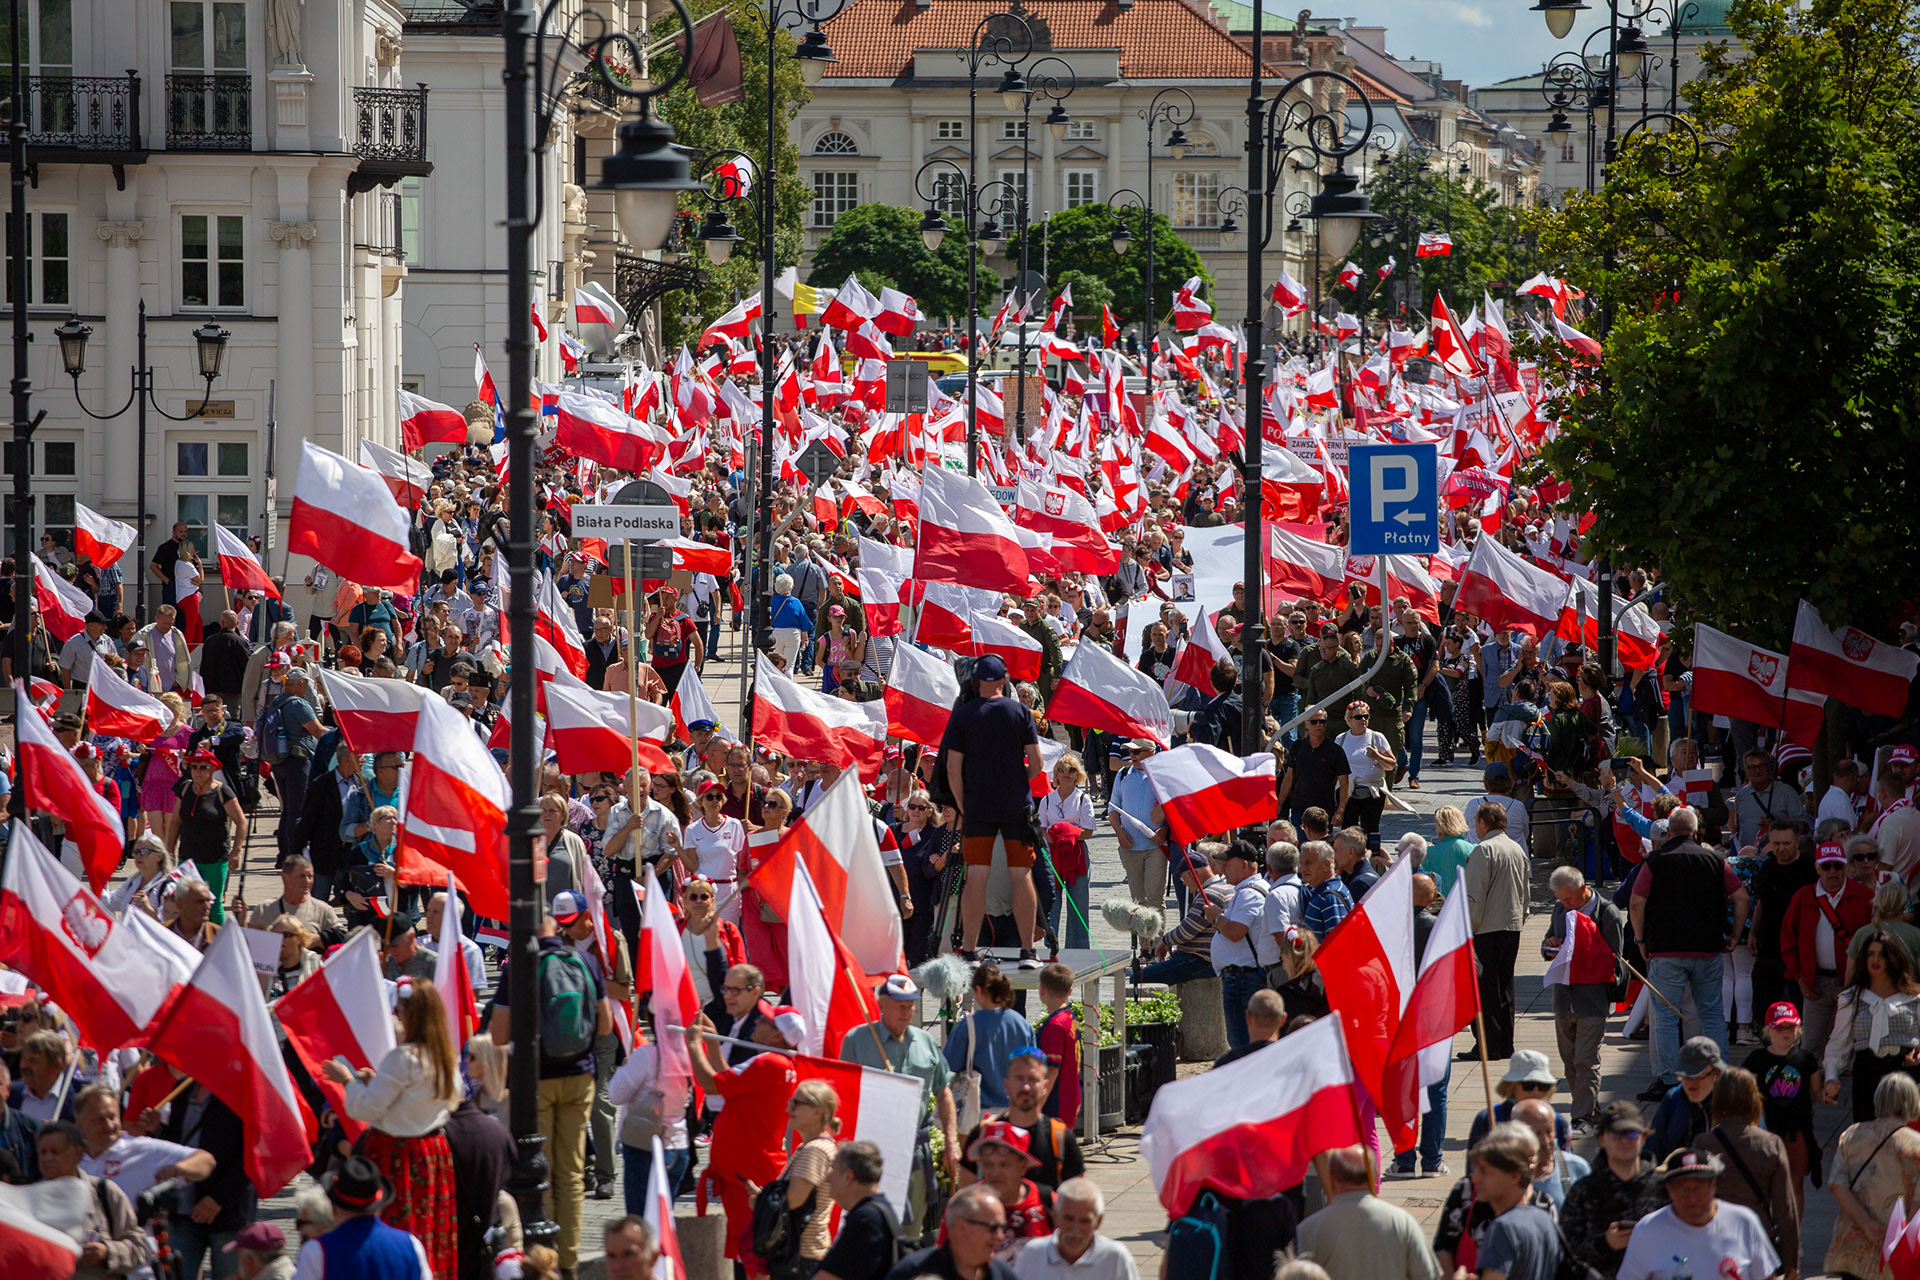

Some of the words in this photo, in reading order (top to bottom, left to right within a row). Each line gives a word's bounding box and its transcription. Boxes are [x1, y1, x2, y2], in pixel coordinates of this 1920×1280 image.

[1291, 440, 1316, 448] ZAWSZ
[1370, 455, 1419, 522] P
[1454, 477, 1496, 494] WEJHER
[576, 516, 611, 528] Biała
[614, 516, 674, 529] Podlaska
[1384, 531, 1431, 546] Płatny
